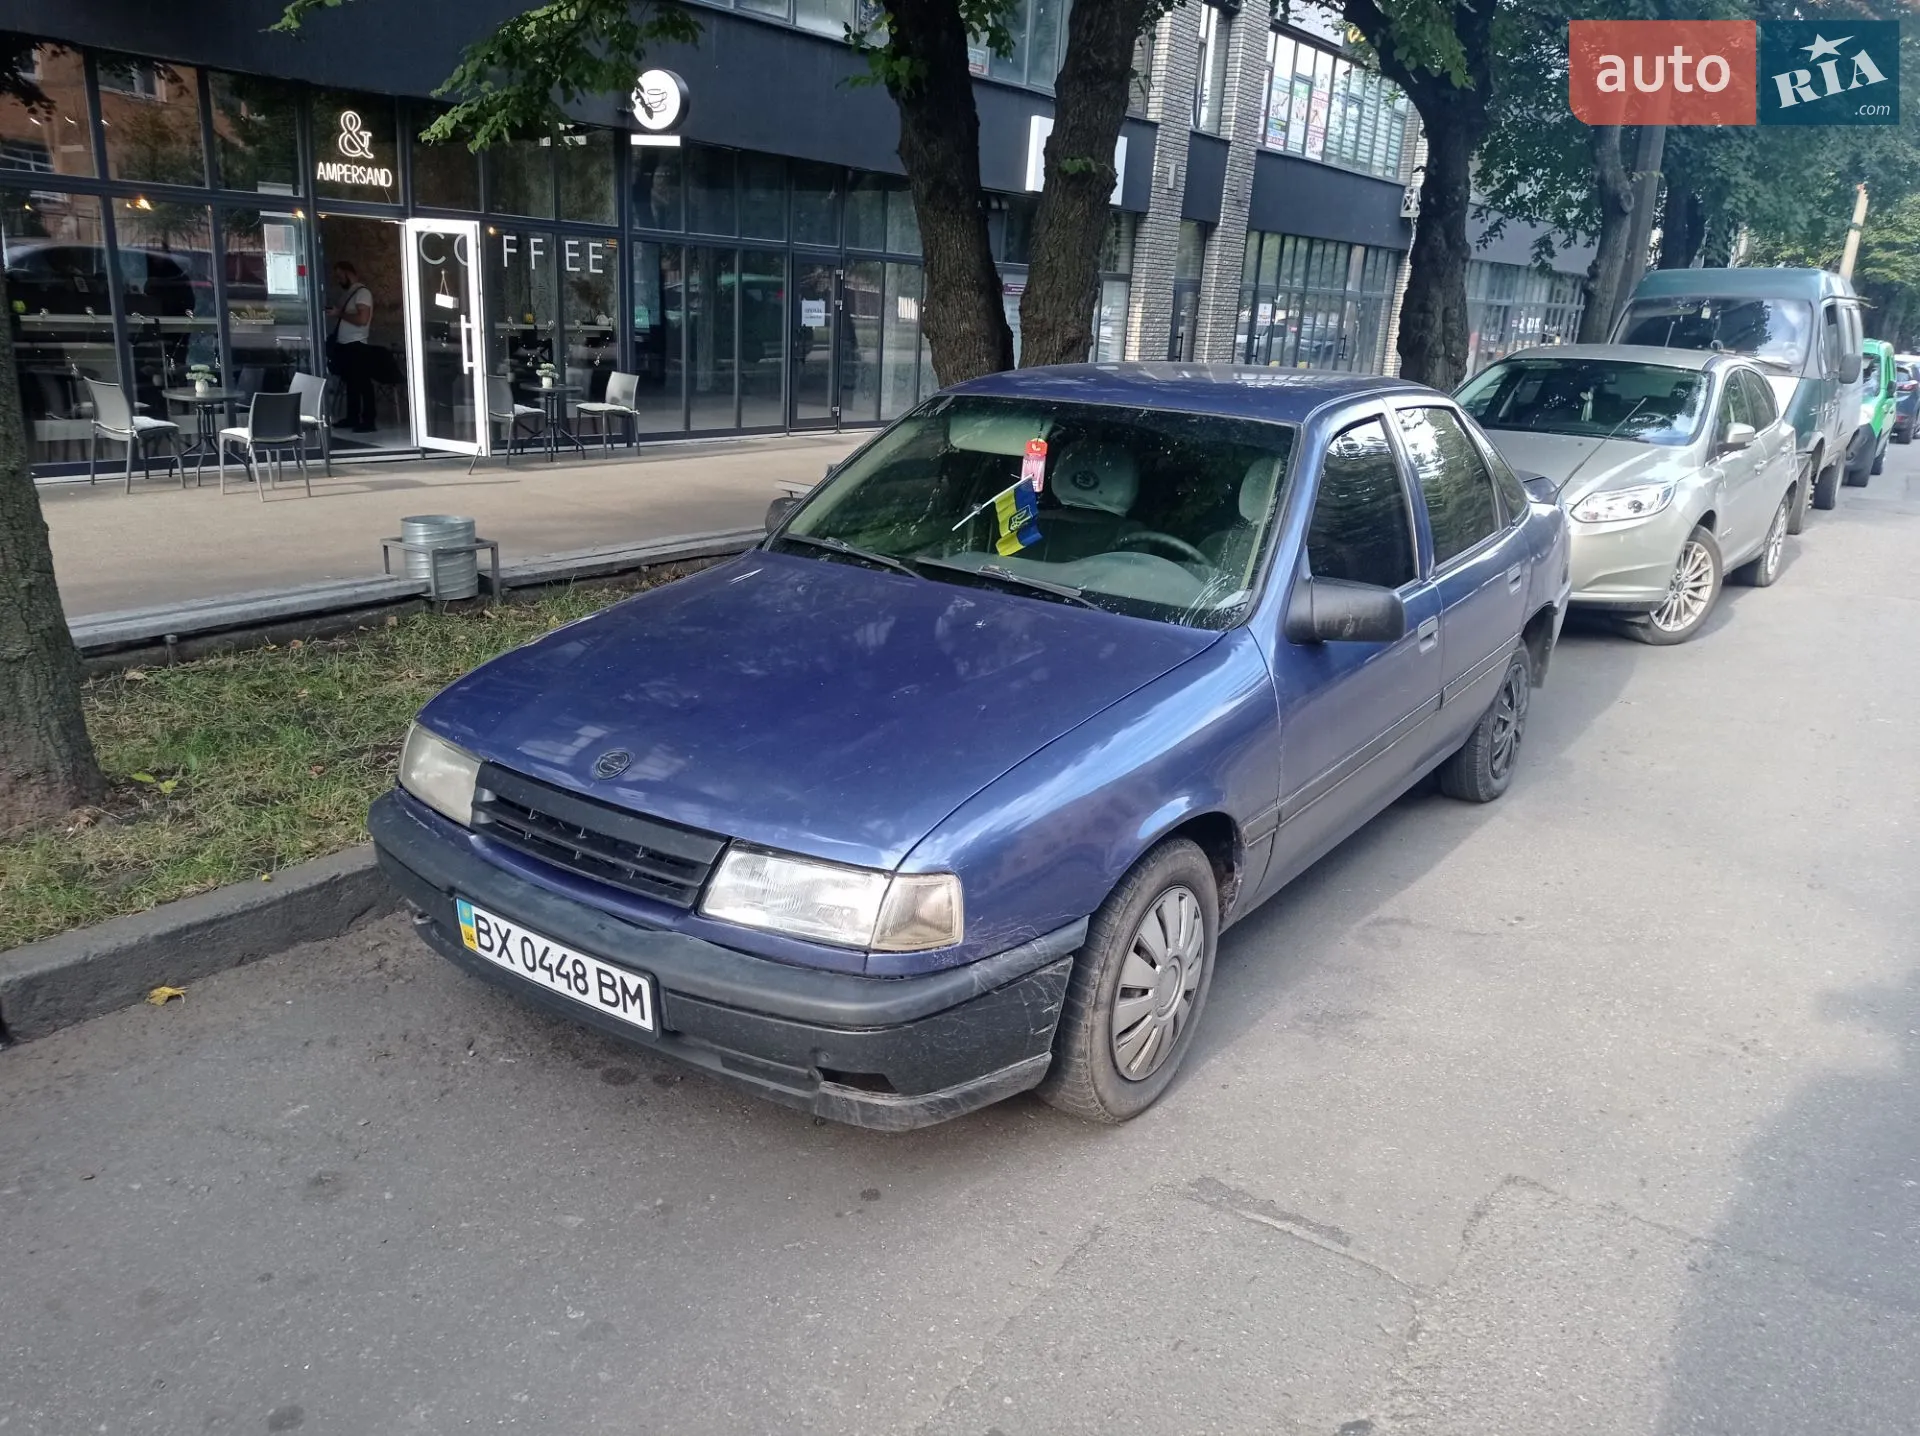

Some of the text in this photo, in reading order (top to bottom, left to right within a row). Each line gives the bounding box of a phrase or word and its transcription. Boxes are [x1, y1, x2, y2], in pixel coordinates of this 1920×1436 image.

[338, 110, 375, 159] &
[317, 161, 393, 187] AMPERSAND
[465, 930, 476, 944] UA
[474, 913, 646, 1021] BX 0448 BM
